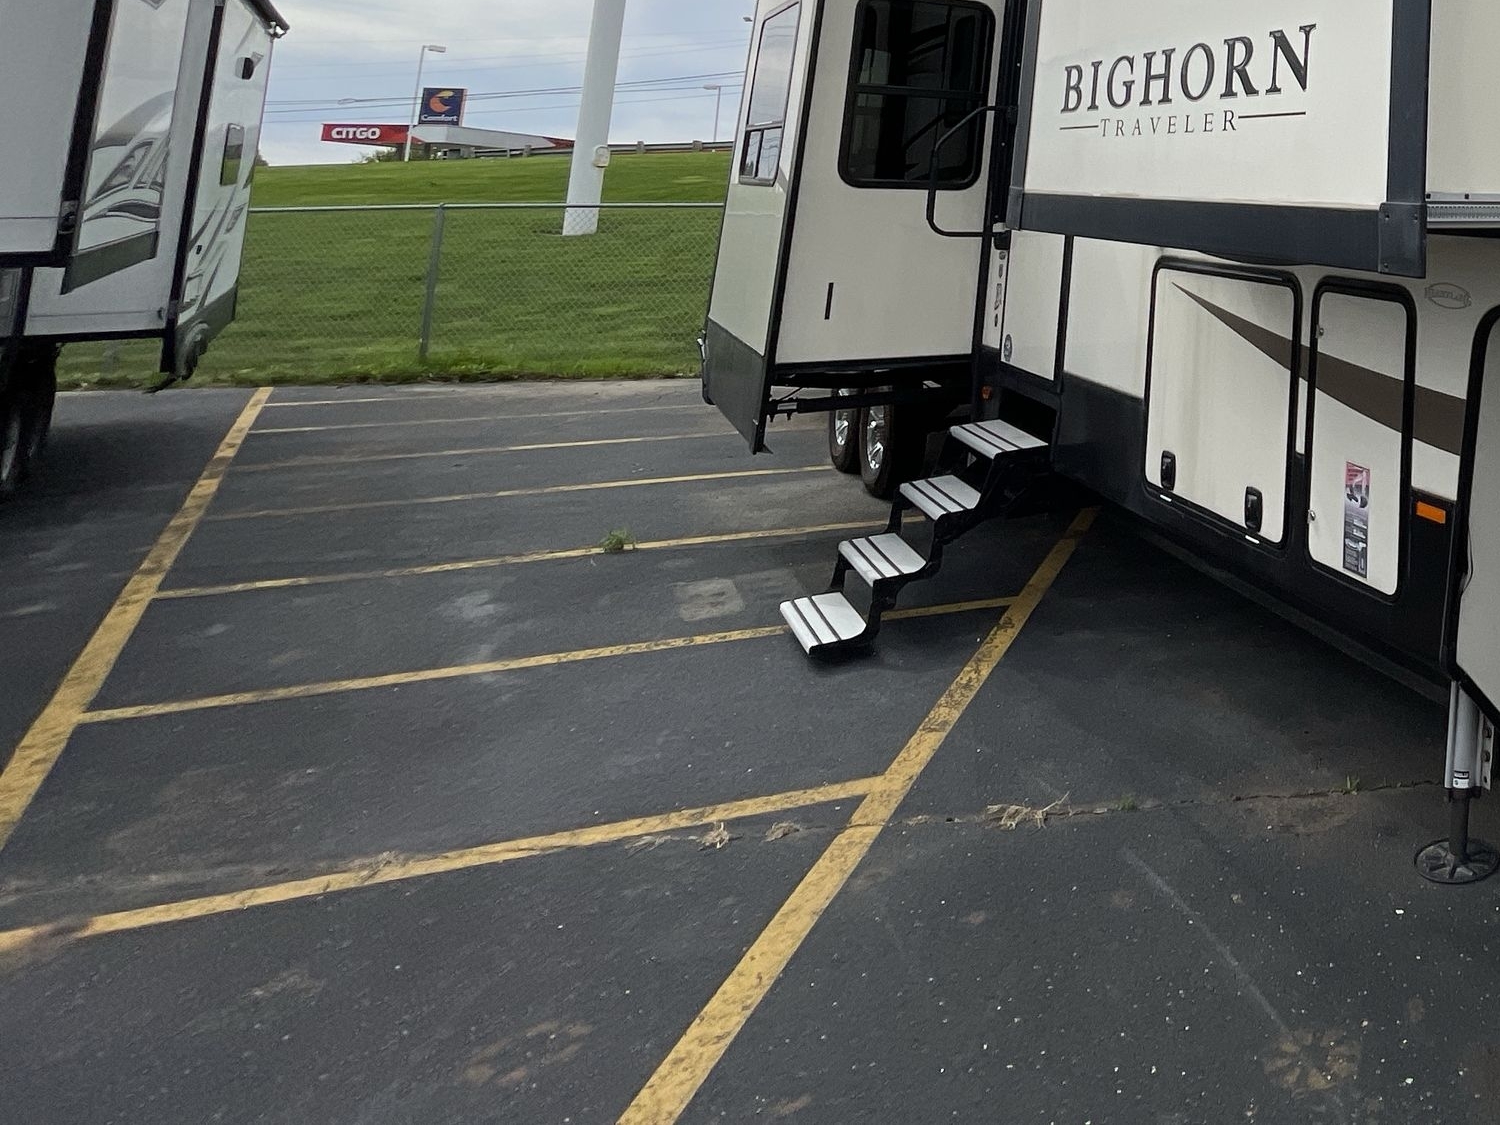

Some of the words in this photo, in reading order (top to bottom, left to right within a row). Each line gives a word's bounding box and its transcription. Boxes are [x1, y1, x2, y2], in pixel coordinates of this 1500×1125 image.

[1060, 24, 1317, 114] BIGHORN
[421, 114, 458, 122] Comfort
[1100, 110, 1237, 137] TRAVELER
[331, 128, 381, 140] CITGO
